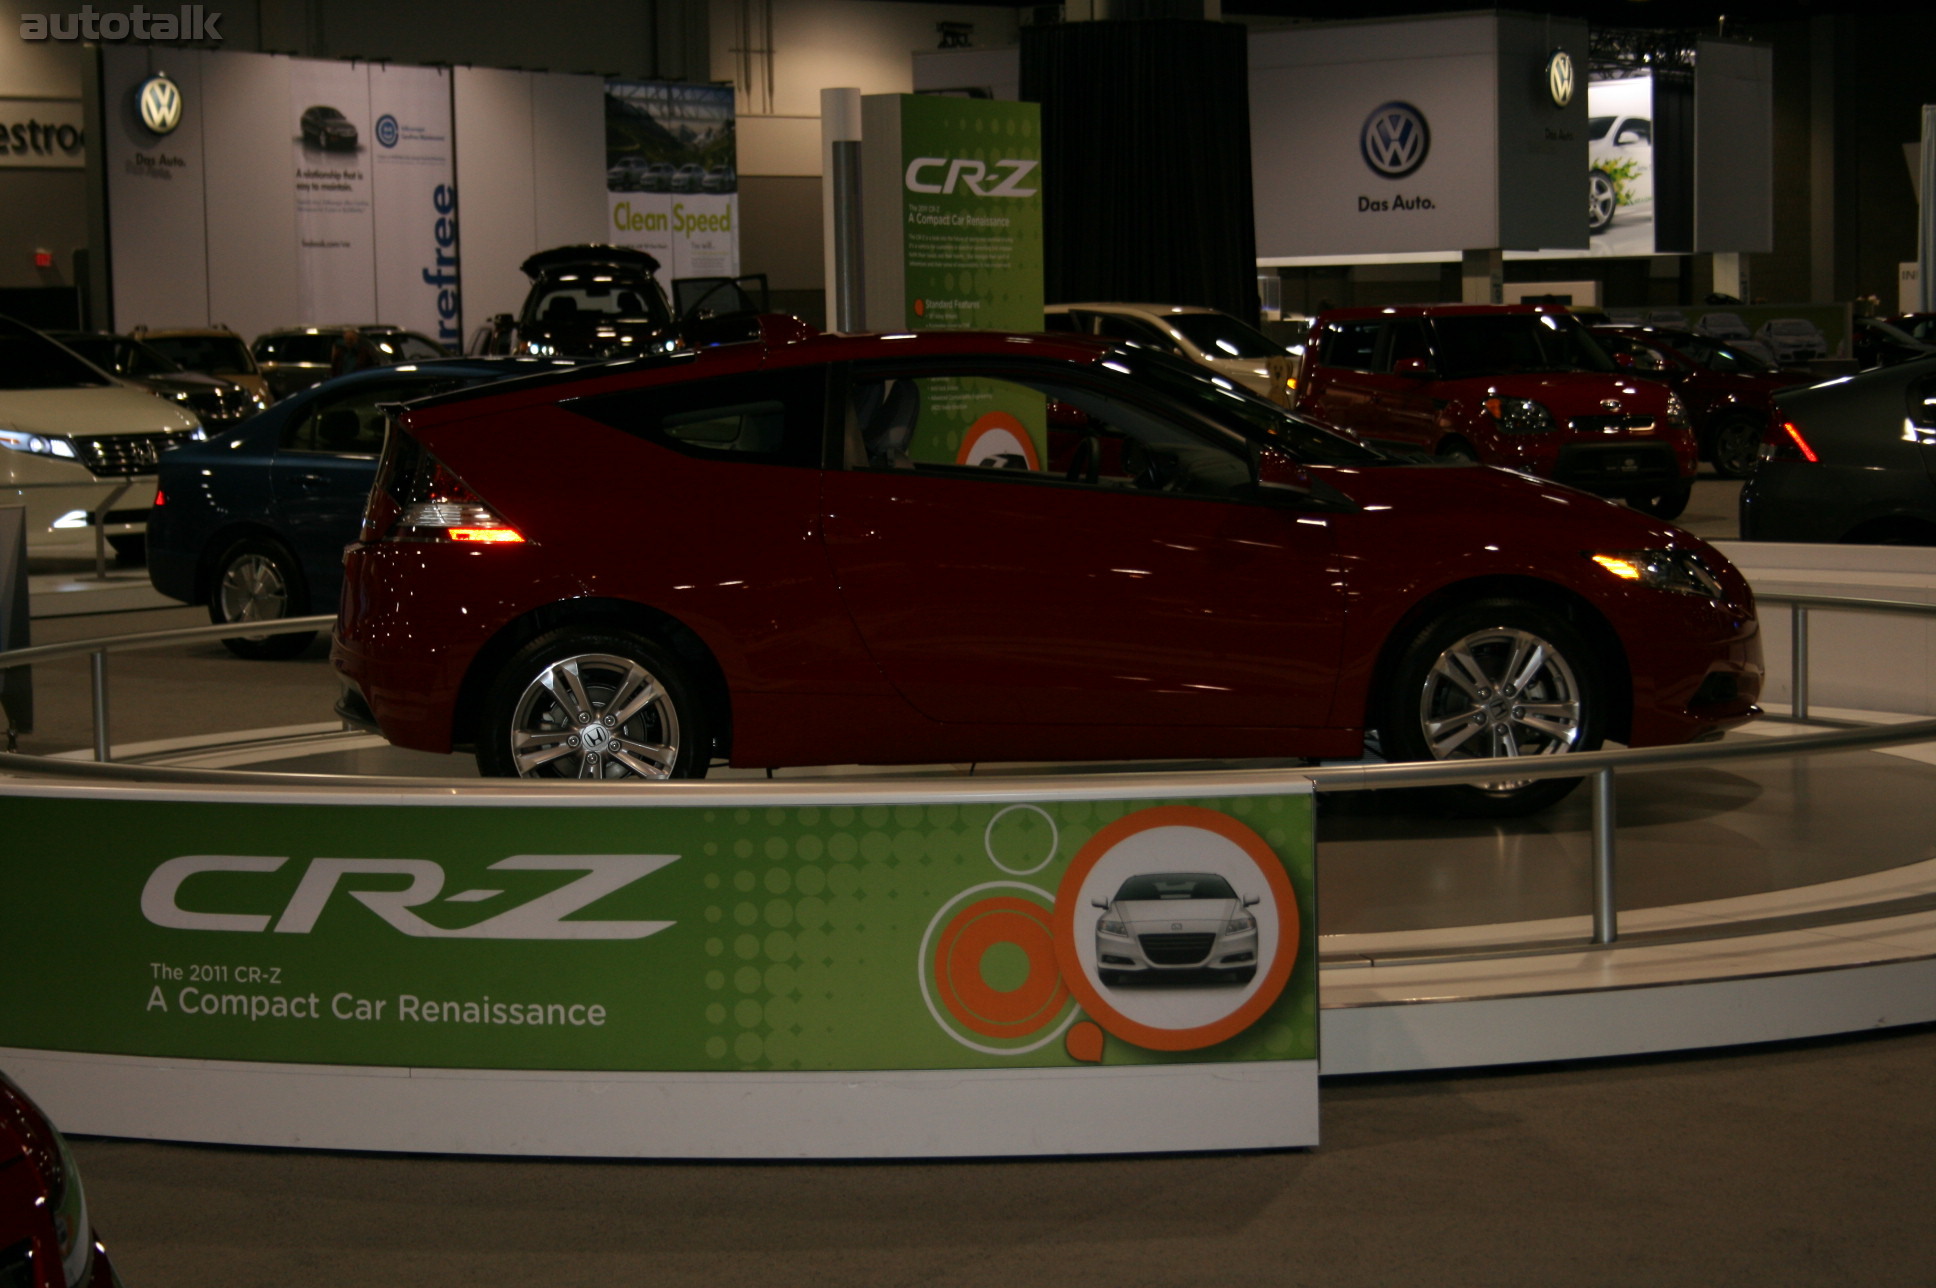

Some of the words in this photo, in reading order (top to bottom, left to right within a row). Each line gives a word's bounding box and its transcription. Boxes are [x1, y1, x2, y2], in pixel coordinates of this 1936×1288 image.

[136, 152, 155, 166] Das
[905, 157, 1039, 197] CR-Z
[1358, 196, 1388, 212] Das
[1392, 194, 1436, 211] Auto.
[614, 202, 667, 231] Clean
[673, 204, 731, 239] Speed
[908, 212, 915, 223] A
[916, 213, 950, 227] Compact
[952, 214, 965, 226] Car
[966, 215, 1010, 227] Renaissance
[140, 854, 682, 940] CR-Z
[150, 962, 183, 981] The
[189, 965, 228, 982] 2011
[234, 966, 282, 984] CR-Z
[146, 985, 168, 1012] A
[179, 986, 320, 1021] Compact
[331, 992, 387, 1020] Car
[398, 994, 606, 1026] Renaissance
